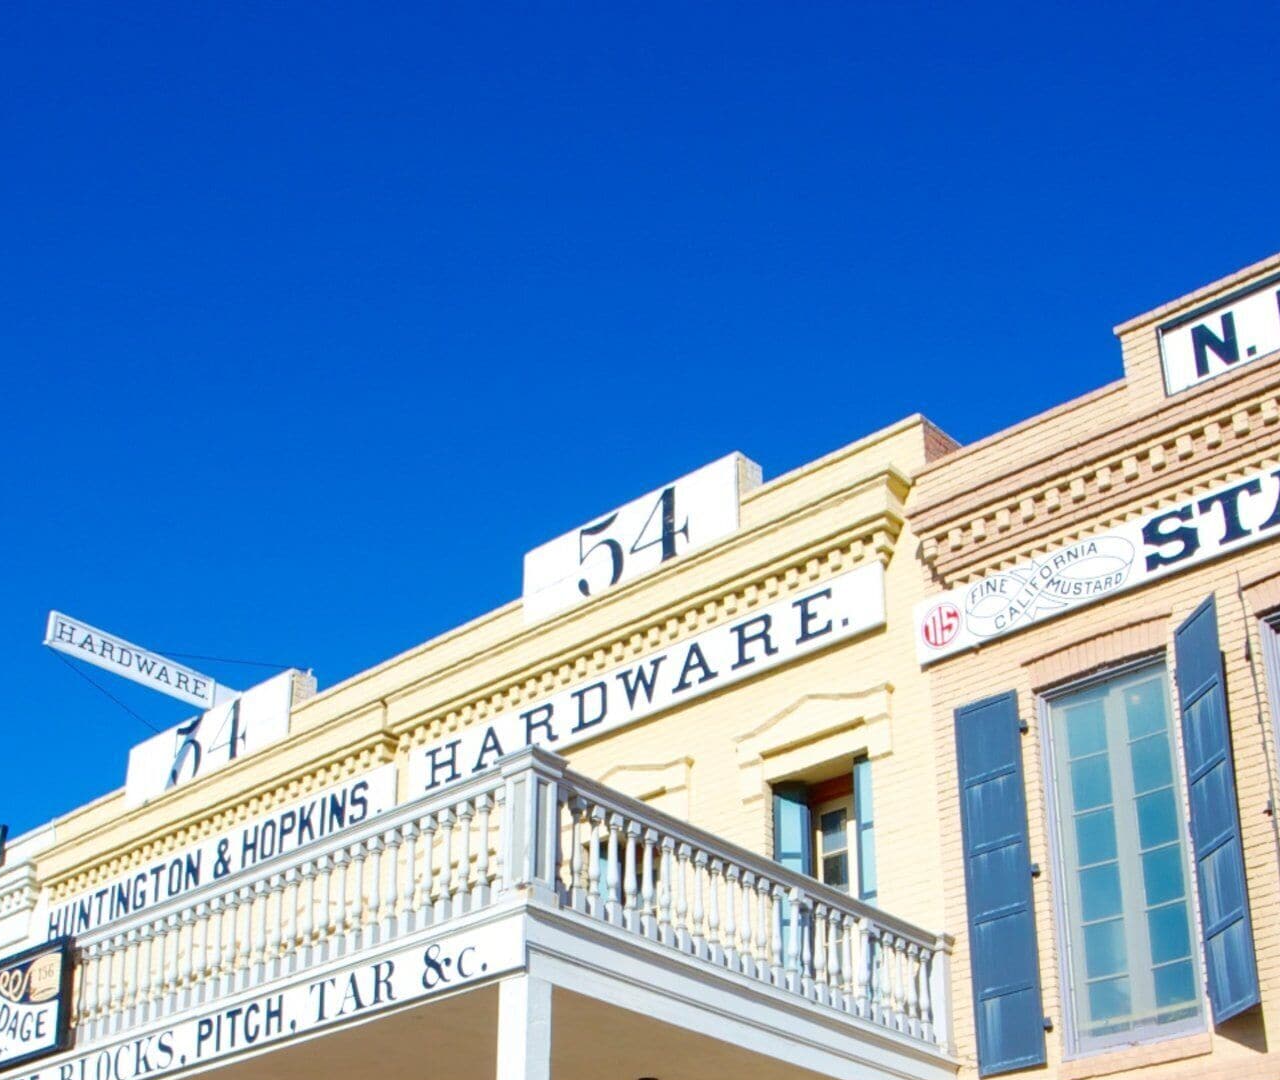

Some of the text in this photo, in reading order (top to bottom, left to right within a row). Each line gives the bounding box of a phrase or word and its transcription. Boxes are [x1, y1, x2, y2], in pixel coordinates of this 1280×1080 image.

[1191, 313, 1257, 378] N.
[577, 485, 690, 597] 54
[971, 577, 1009, 604] FINE
[994, 541, 1098, 630] CALIFORNIA
[1045, 572, 1122, 596] MUSTARD
[56, 621, 209, 700] HARDWARE.
[425, 588, 850, 790] HARDWARE.
[47, 780, 382, 940] HUNTINGTON & HOPKINS.
[309, 960, 398, 1023] TAR
